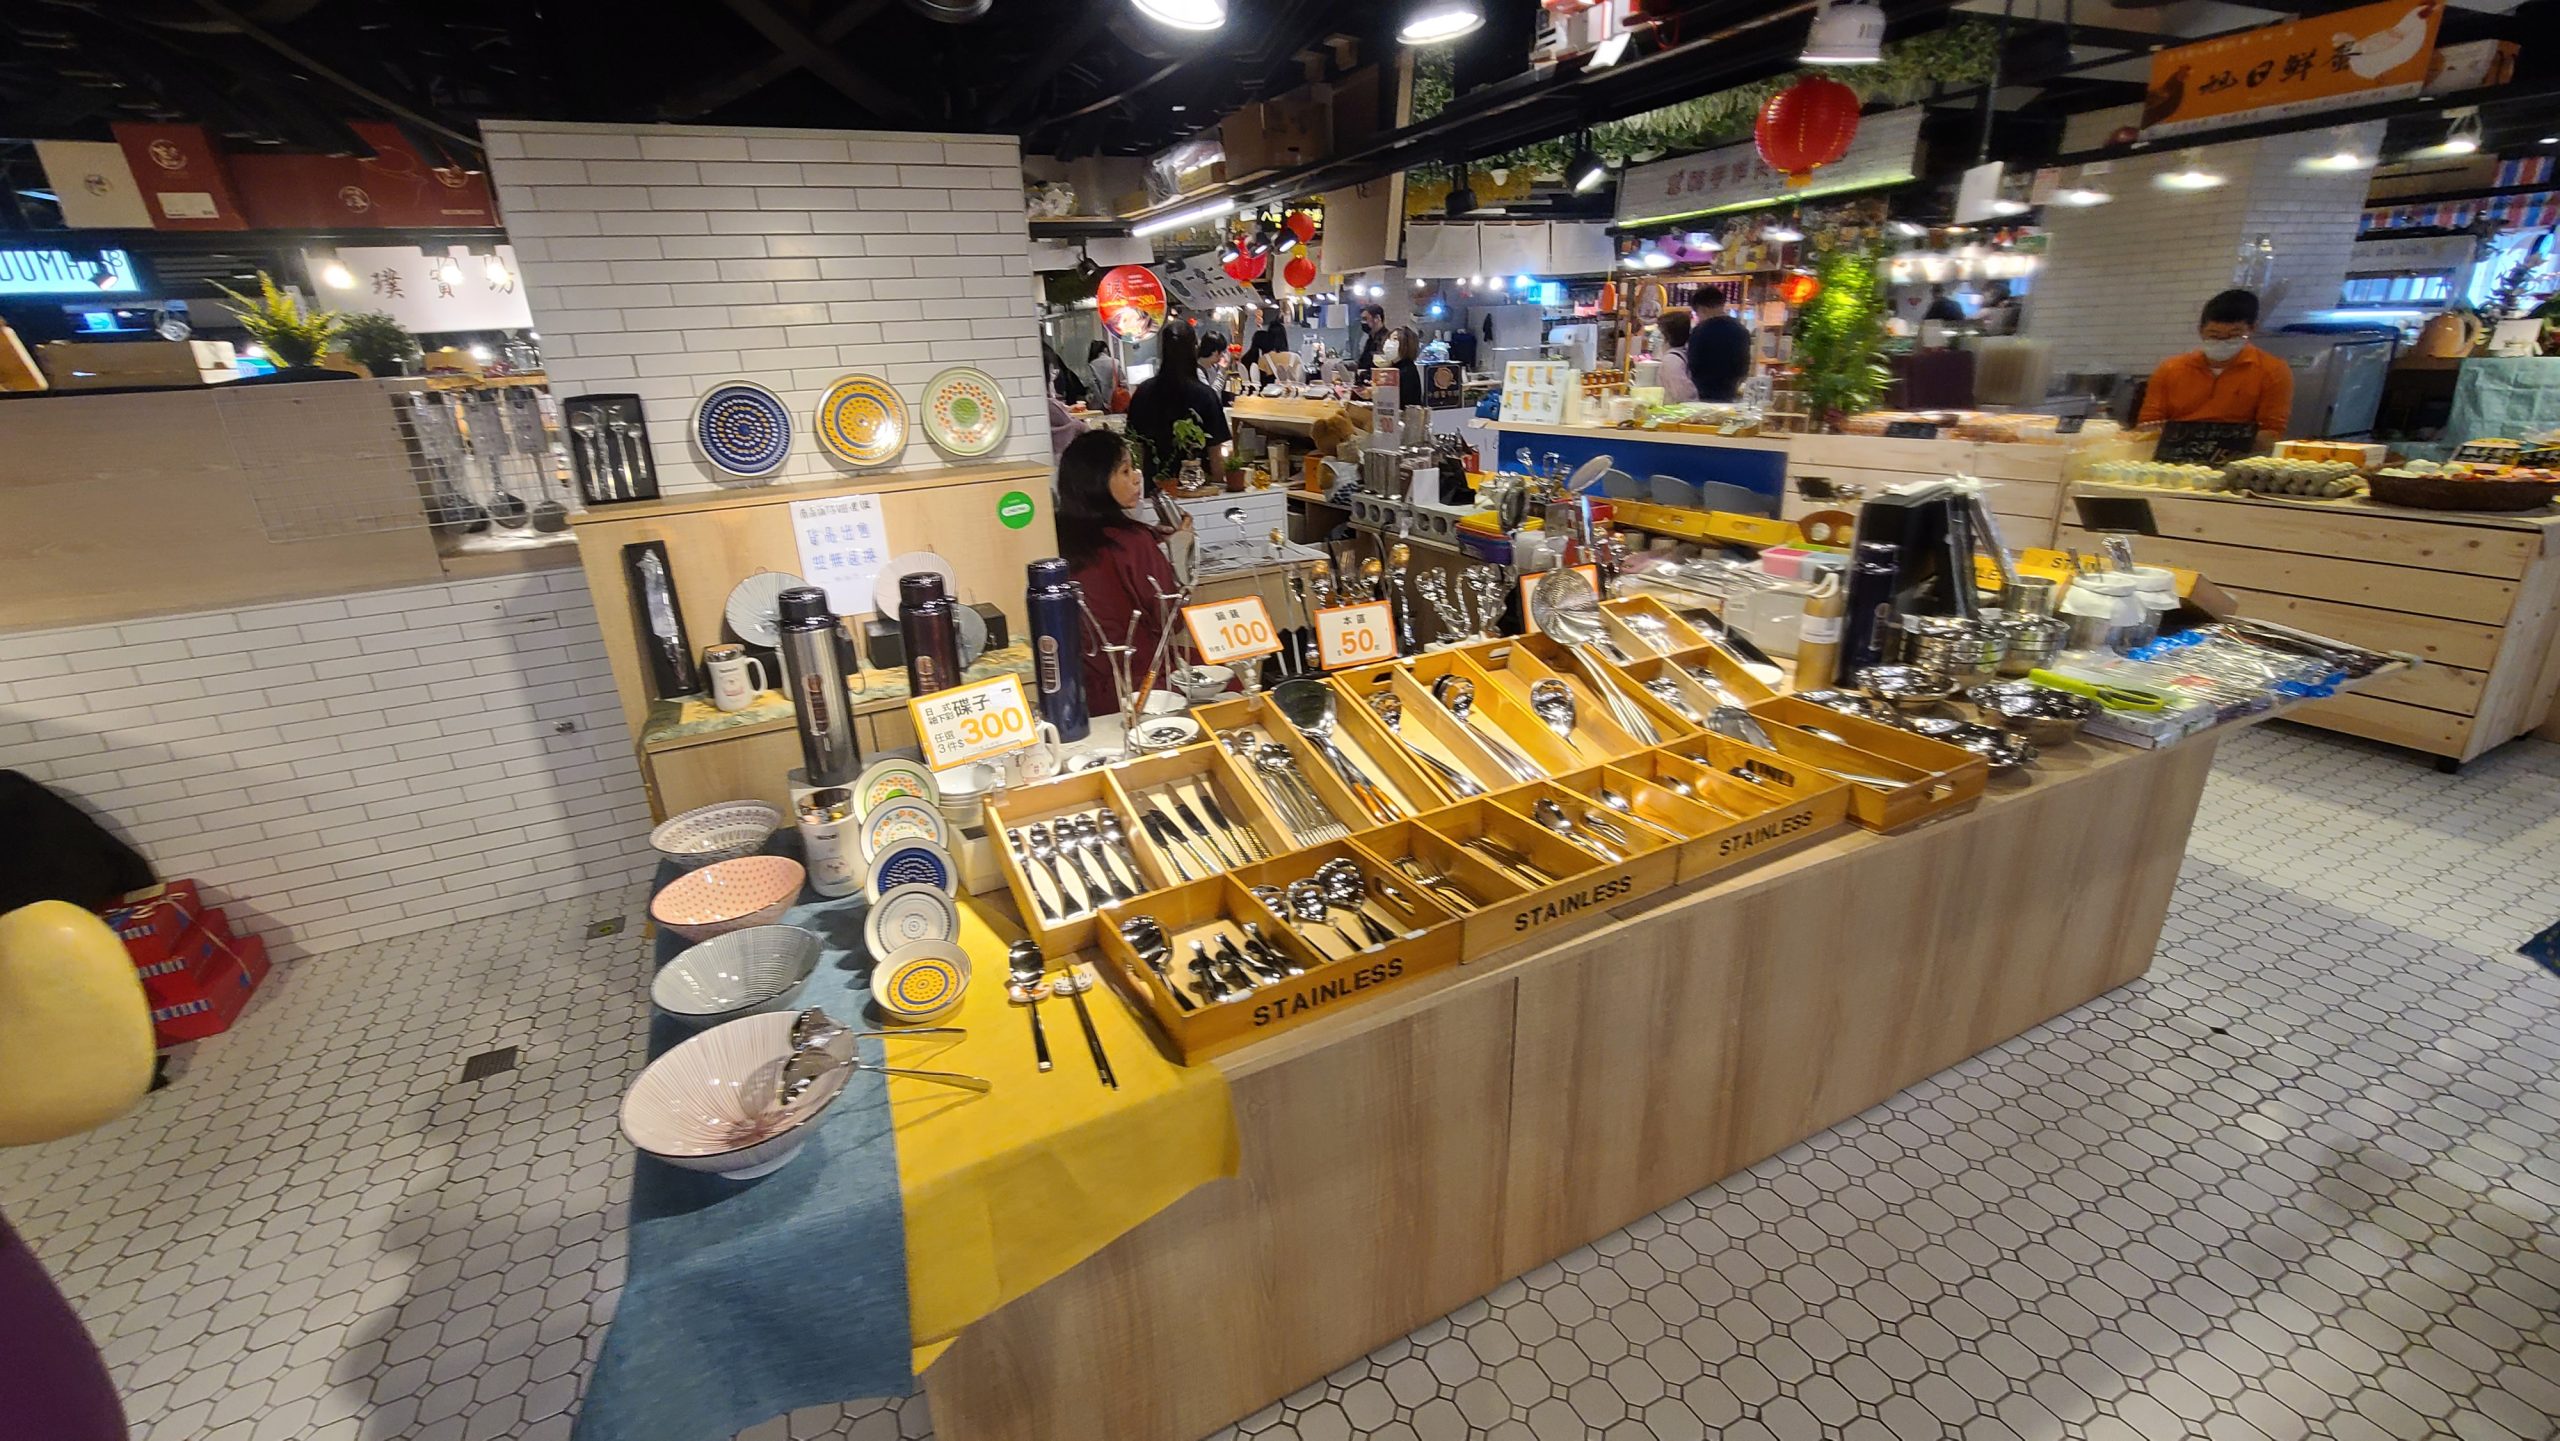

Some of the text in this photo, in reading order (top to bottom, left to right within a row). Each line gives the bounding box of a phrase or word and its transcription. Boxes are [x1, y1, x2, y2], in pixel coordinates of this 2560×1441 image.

[1221, 622, 1267, 648] 100
[1341, 629, 1373, 654] 50
[951, 694, 990, 717] 碟子
[961, 707, 1023, 744] 300
[1720, 810, 1813, 856] STAINLESS
[1514, 875, 1632, 931] STAINLESS
[1254, 958, 1404, 1026] STAINLESS
